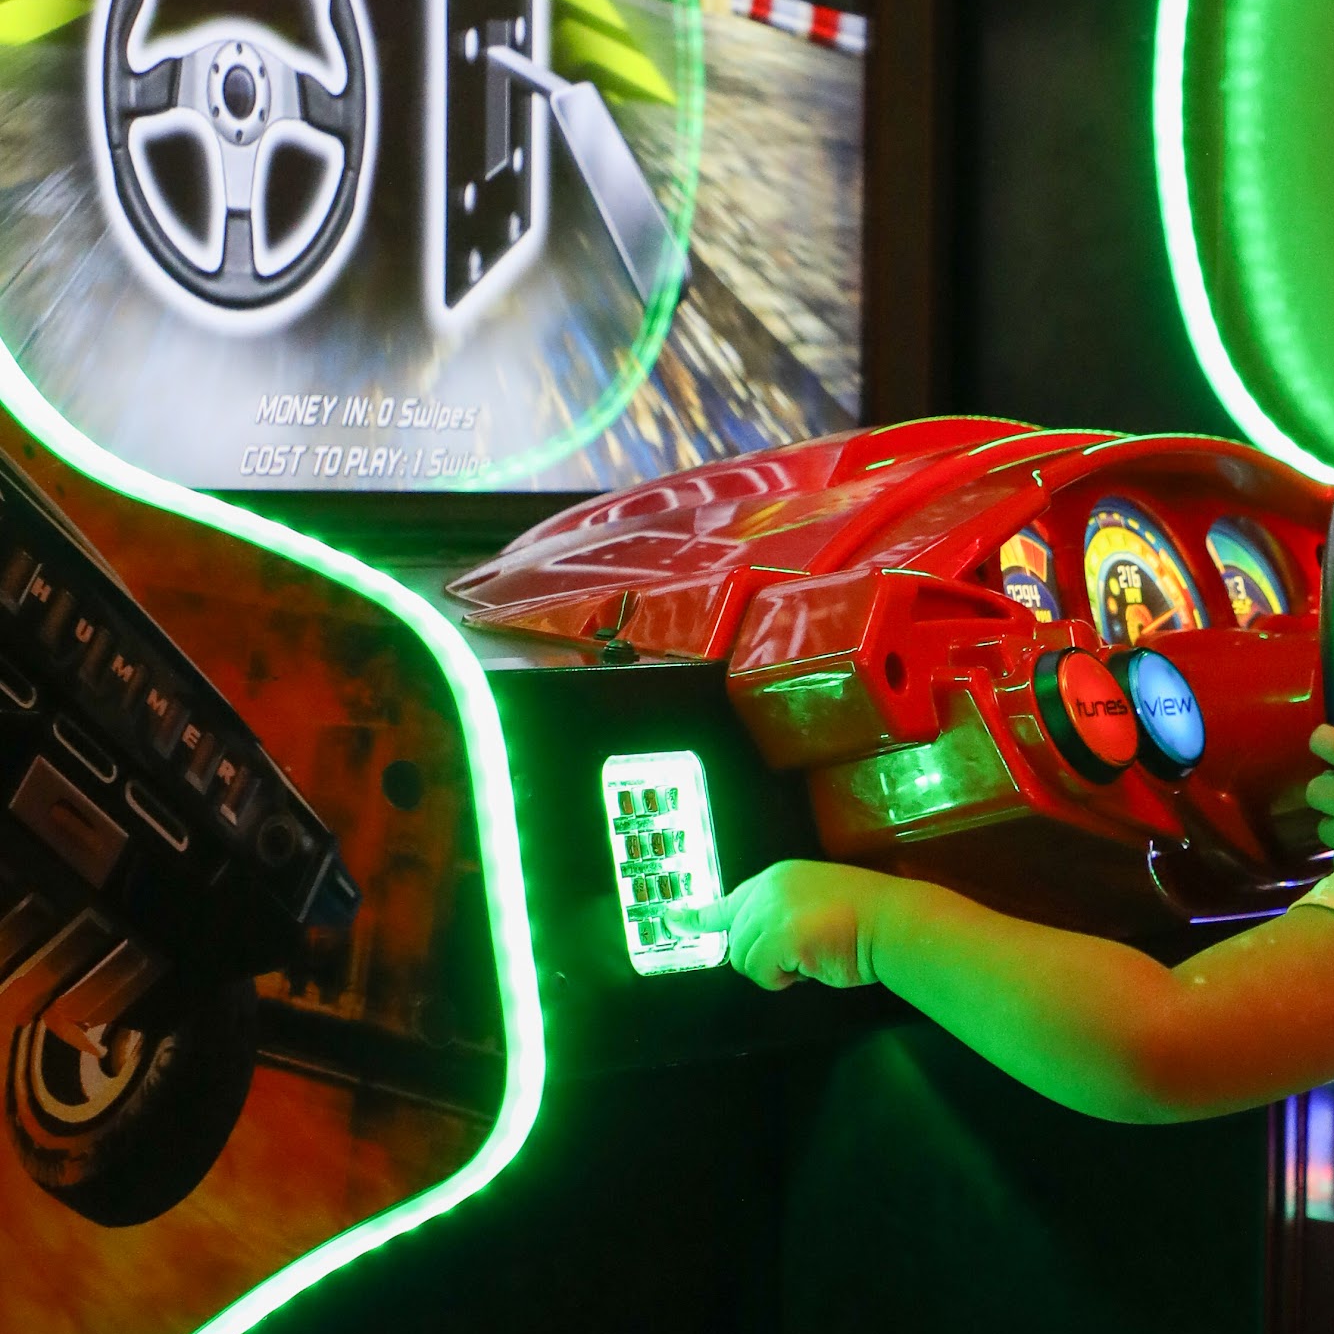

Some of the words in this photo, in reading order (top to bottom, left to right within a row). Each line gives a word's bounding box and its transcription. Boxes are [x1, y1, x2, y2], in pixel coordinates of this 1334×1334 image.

[254, 393, 339, 428] MONEY
[341, 396, 373, 429] IN:
[376, 396, 396, 430] 0
[396, 397, 480, 433] Swipes
[239, 444, 308, 478] COST
[313, 444, 343, 478] TO
[343, 446, 408, 479] PLAY:
[424, 447, 493, 481] Swipe
[1117, 564, 1142, 589] 216
[1006, 584, 1042, 609] 7294
[30, 577, 238, 785] HUMMER
[1075, 697, 1129, 717] tunes
[1143, 695, 1193, 718] view
